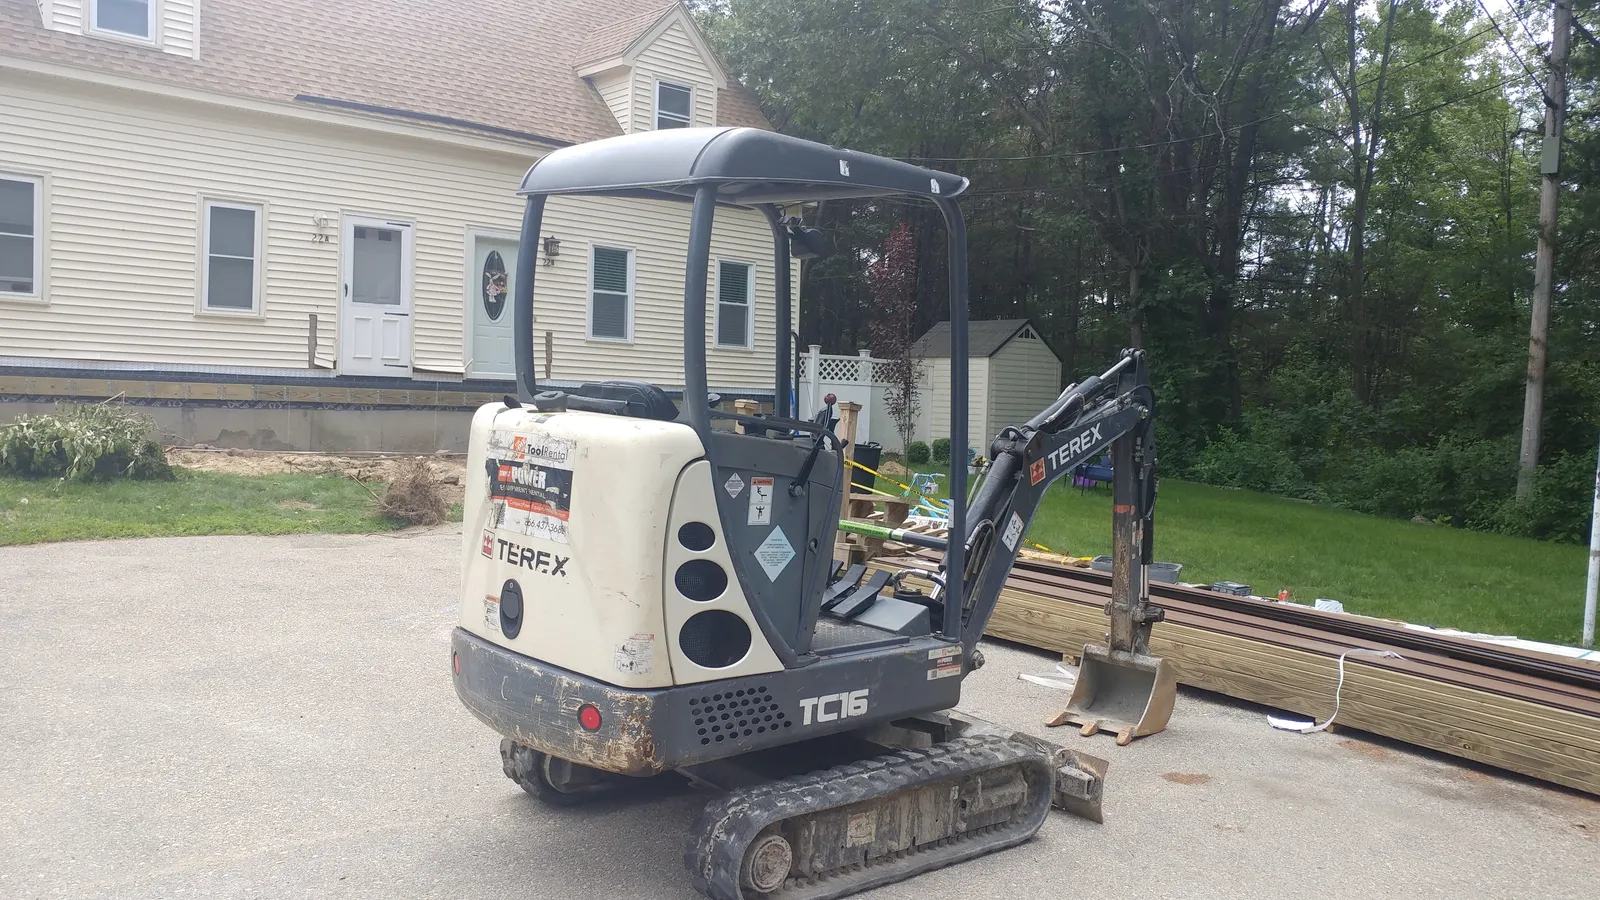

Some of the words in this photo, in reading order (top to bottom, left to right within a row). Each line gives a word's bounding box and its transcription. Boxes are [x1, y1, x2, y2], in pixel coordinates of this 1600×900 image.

[311, 233, 329, 243] 22A
[1048, 422, 1103, 471] TEREX
[512, 466, 547, 489] POWER
[497, 538, 570, 577] TEREX
[799, 688, 870, 726] TC16
